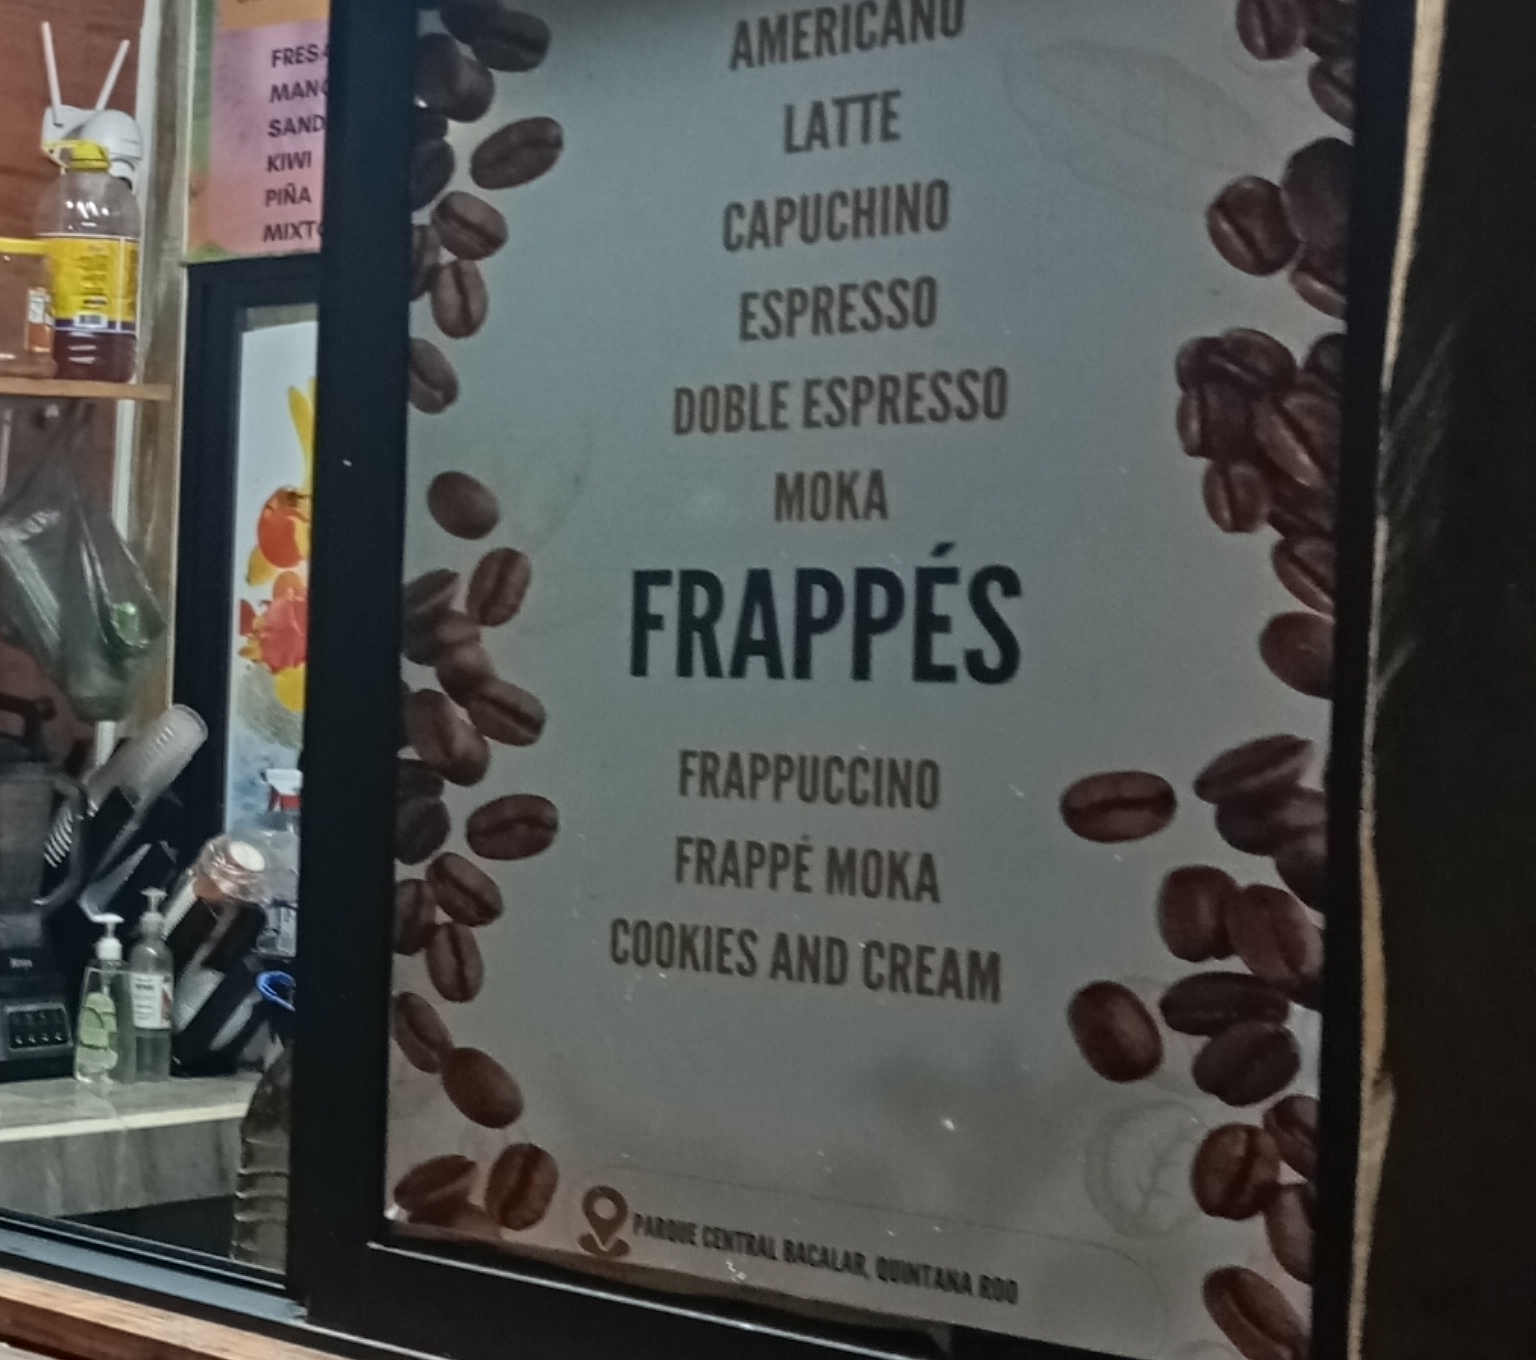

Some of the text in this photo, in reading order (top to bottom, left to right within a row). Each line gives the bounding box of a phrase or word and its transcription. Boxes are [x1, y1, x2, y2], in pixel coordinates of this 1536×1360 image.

[783, 89, 902, 154] LATTE
[264, 182, 312, 208] PIÑA
[266, 150, 313, 173] KIWI
[722, 178, 950, 252] CAPUCHINO
[738, 275, 939, 342] ESPRESSO
[672, 366, 1009, 436] DOBLE ESPRESSO
[774, 469, 889, 523] MOKA
[629, 542, 1024, 685] FRAPPÉS
[678, 749, 942, 810] FRAPPUCCINO
[675, 834, 941, 904] FRAPPÉ MOKA
[610, 917, 1002, 1004] COOKIES AND CREAM
[632, 1212, 697, 1246] PARQUE
[701, 1225, 778, 1260] CENTRAL
[876, 1255, 974, 1297] QUINTANA
[979, 1274, 1019, 1305] ROO
